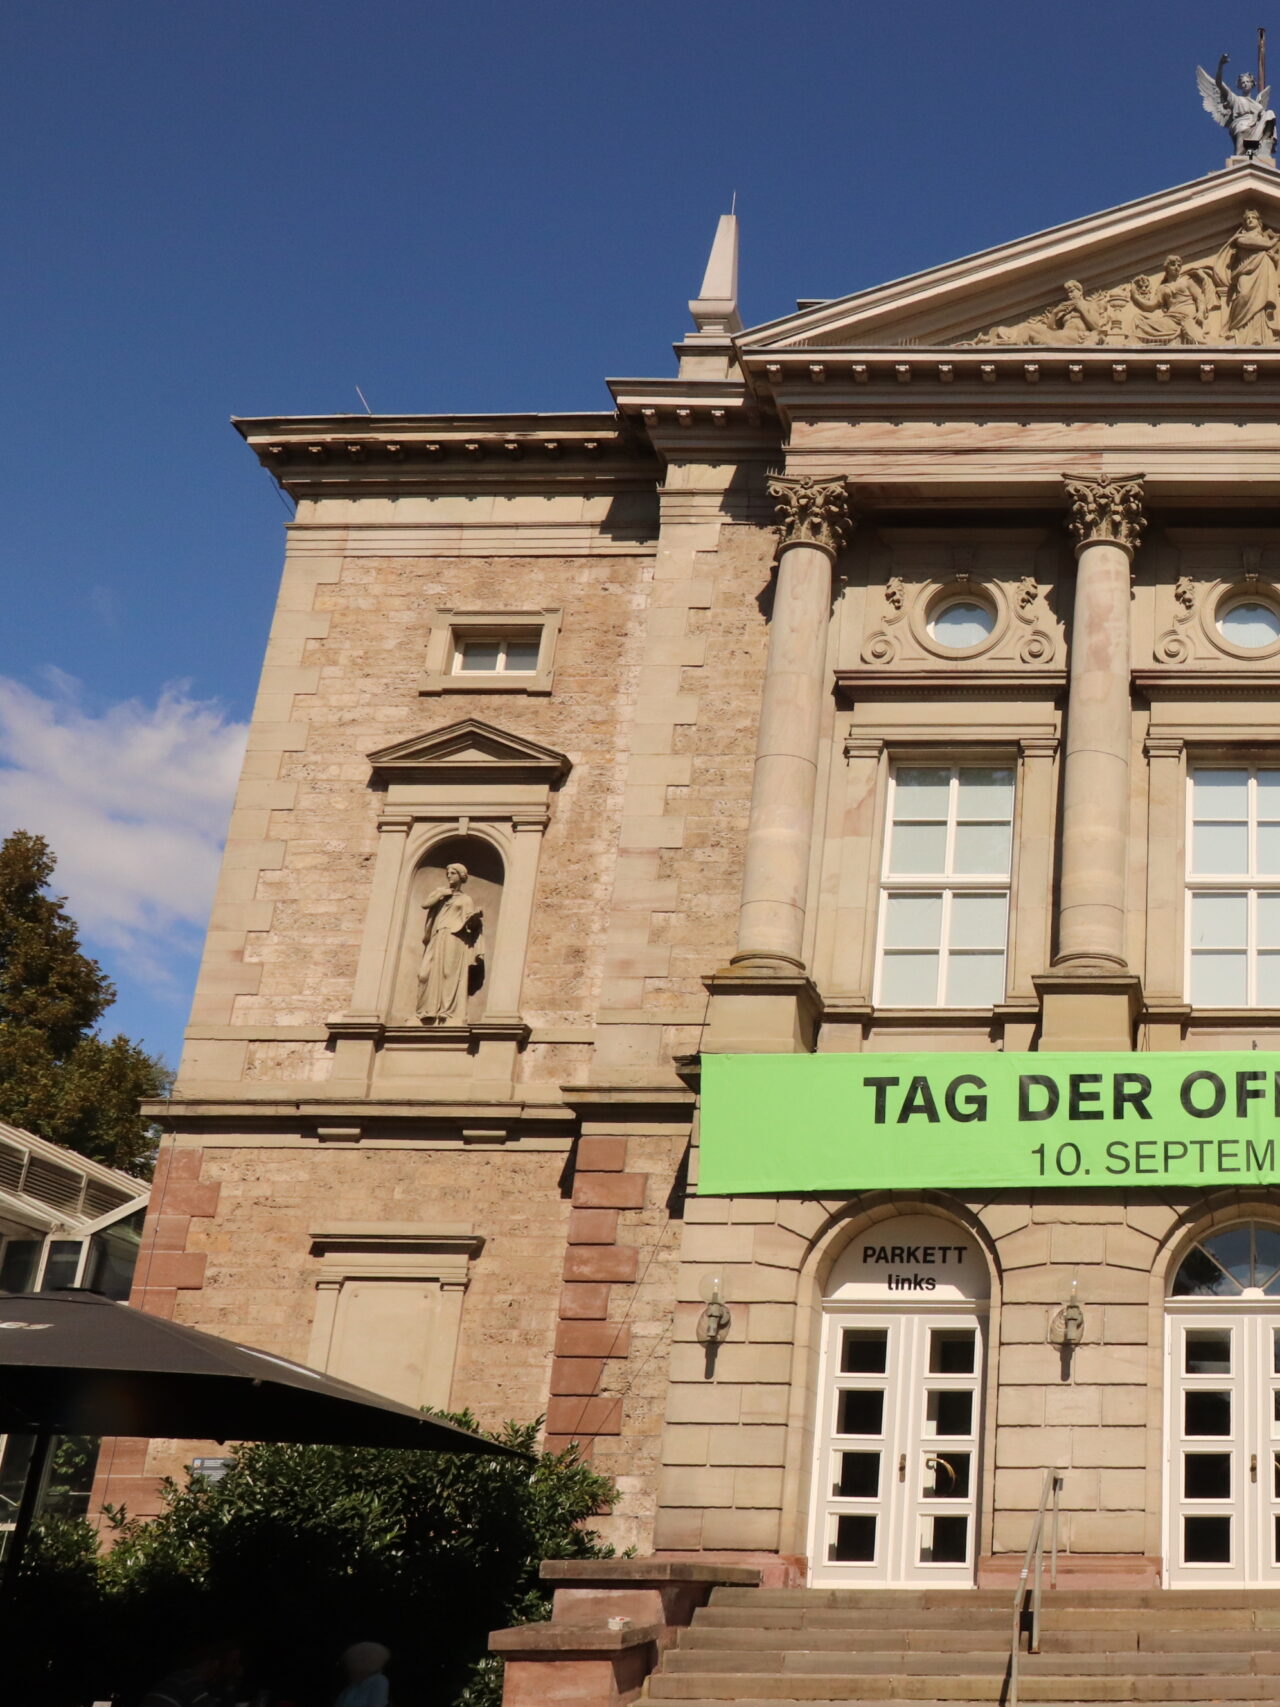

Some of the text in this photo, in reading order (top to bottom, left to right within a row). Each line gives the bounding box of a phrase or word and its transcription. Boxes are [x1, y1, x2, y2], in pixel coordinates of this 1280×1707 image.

[863, 1073, 988, 1125] TAG
[1018, 1072, 1153, 1122] DER
[1031, 1142, 1090, 1177] 10.
[862, 1245, 968, 1265] PARKETT
[887, 1273, 937, 1291] links
